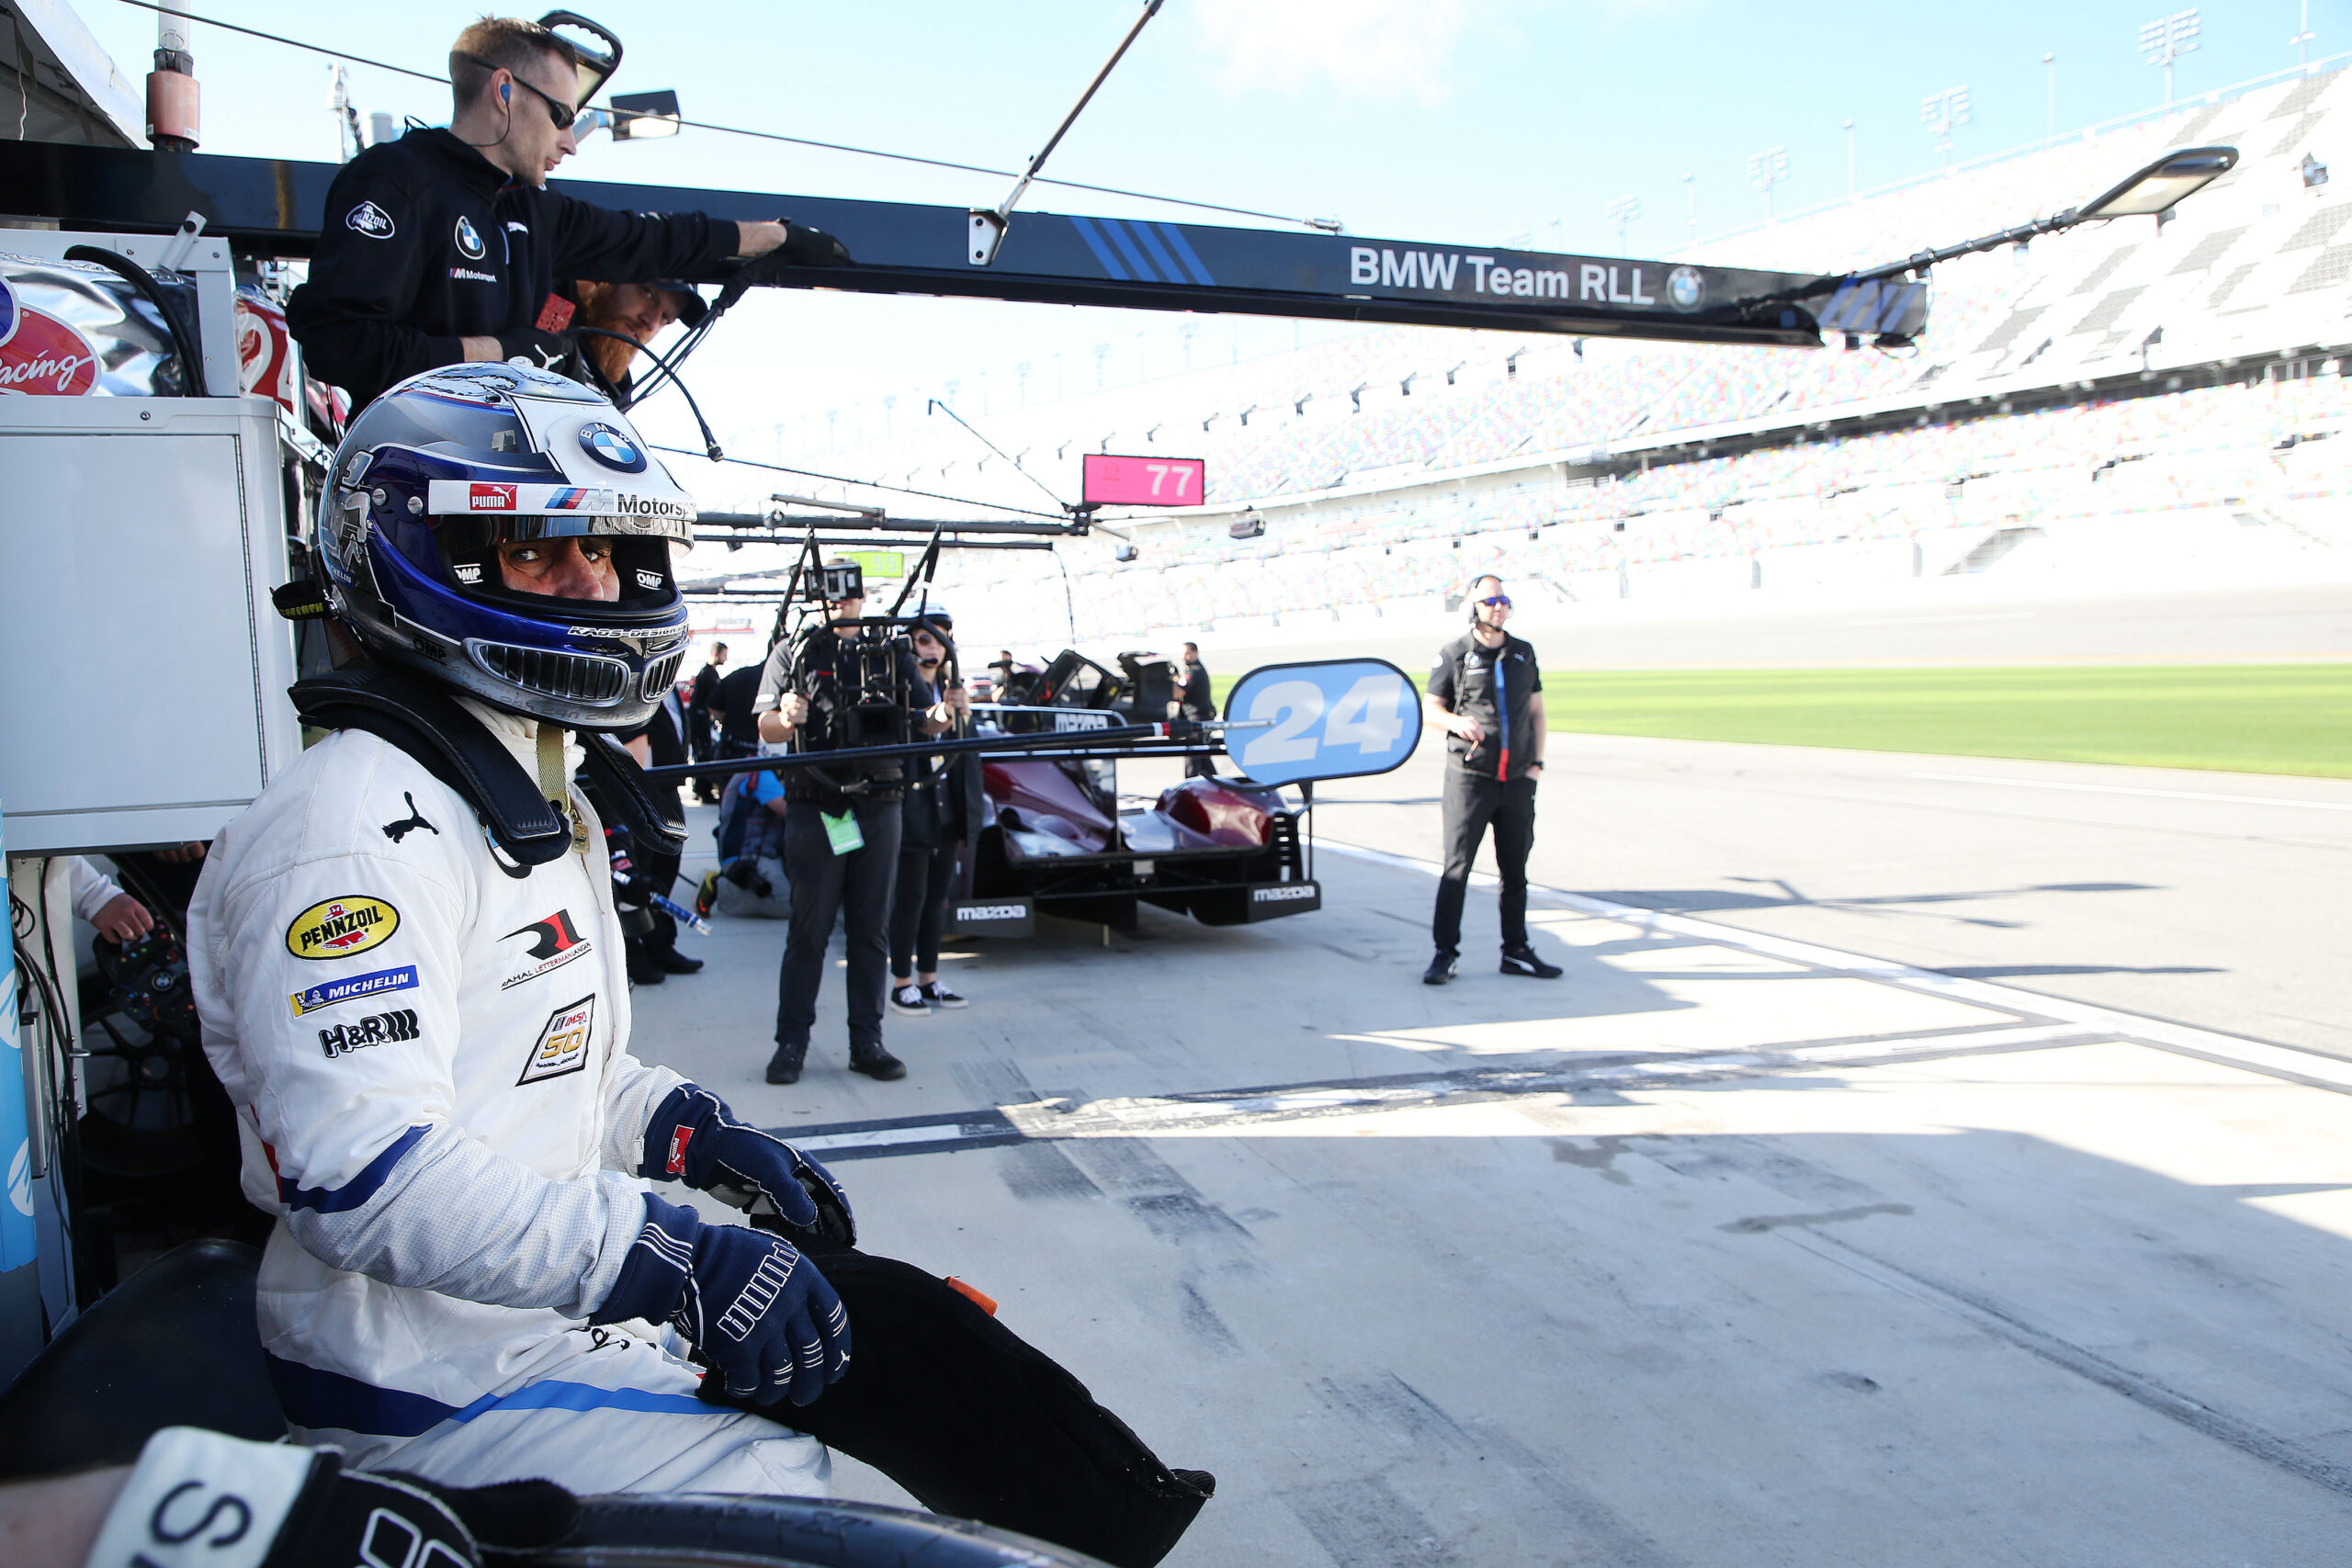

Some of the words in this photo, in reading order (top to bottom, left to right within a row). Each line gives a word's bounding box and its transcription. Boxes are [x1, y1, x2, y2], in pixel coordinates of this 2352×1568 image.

[1351, 246, 1459, 291] BMW
[1465, 254, 1569, 299] Team
[1580, 263, 1655, 305] RLL
[0, 348, 93, 392] acing
[580, 423, 631, 443] BMW
[1147, 465, 1193, 497] 77
[472, 496, 505, 508] PUMA
[873, 556, 898, 572] 55
[637, 573, 662, 590] OMP
[413, 638, 447, 660] OMP
[1242, 674, 1404, 766] 24
[1254, 886, 1316, 902] mazda
[956, 905, 1027, 920] mazda
[300, 906, 384, 952] PENNZOIL
[328, 973, 410, 999] MICHELIN
[564, 1010, 588, 1027] IMSA
[319, 1015, 390, 1058] H&R
[540, 1026, 585, 1060] 50
[717, 1240, 800, 1342] PUMA
